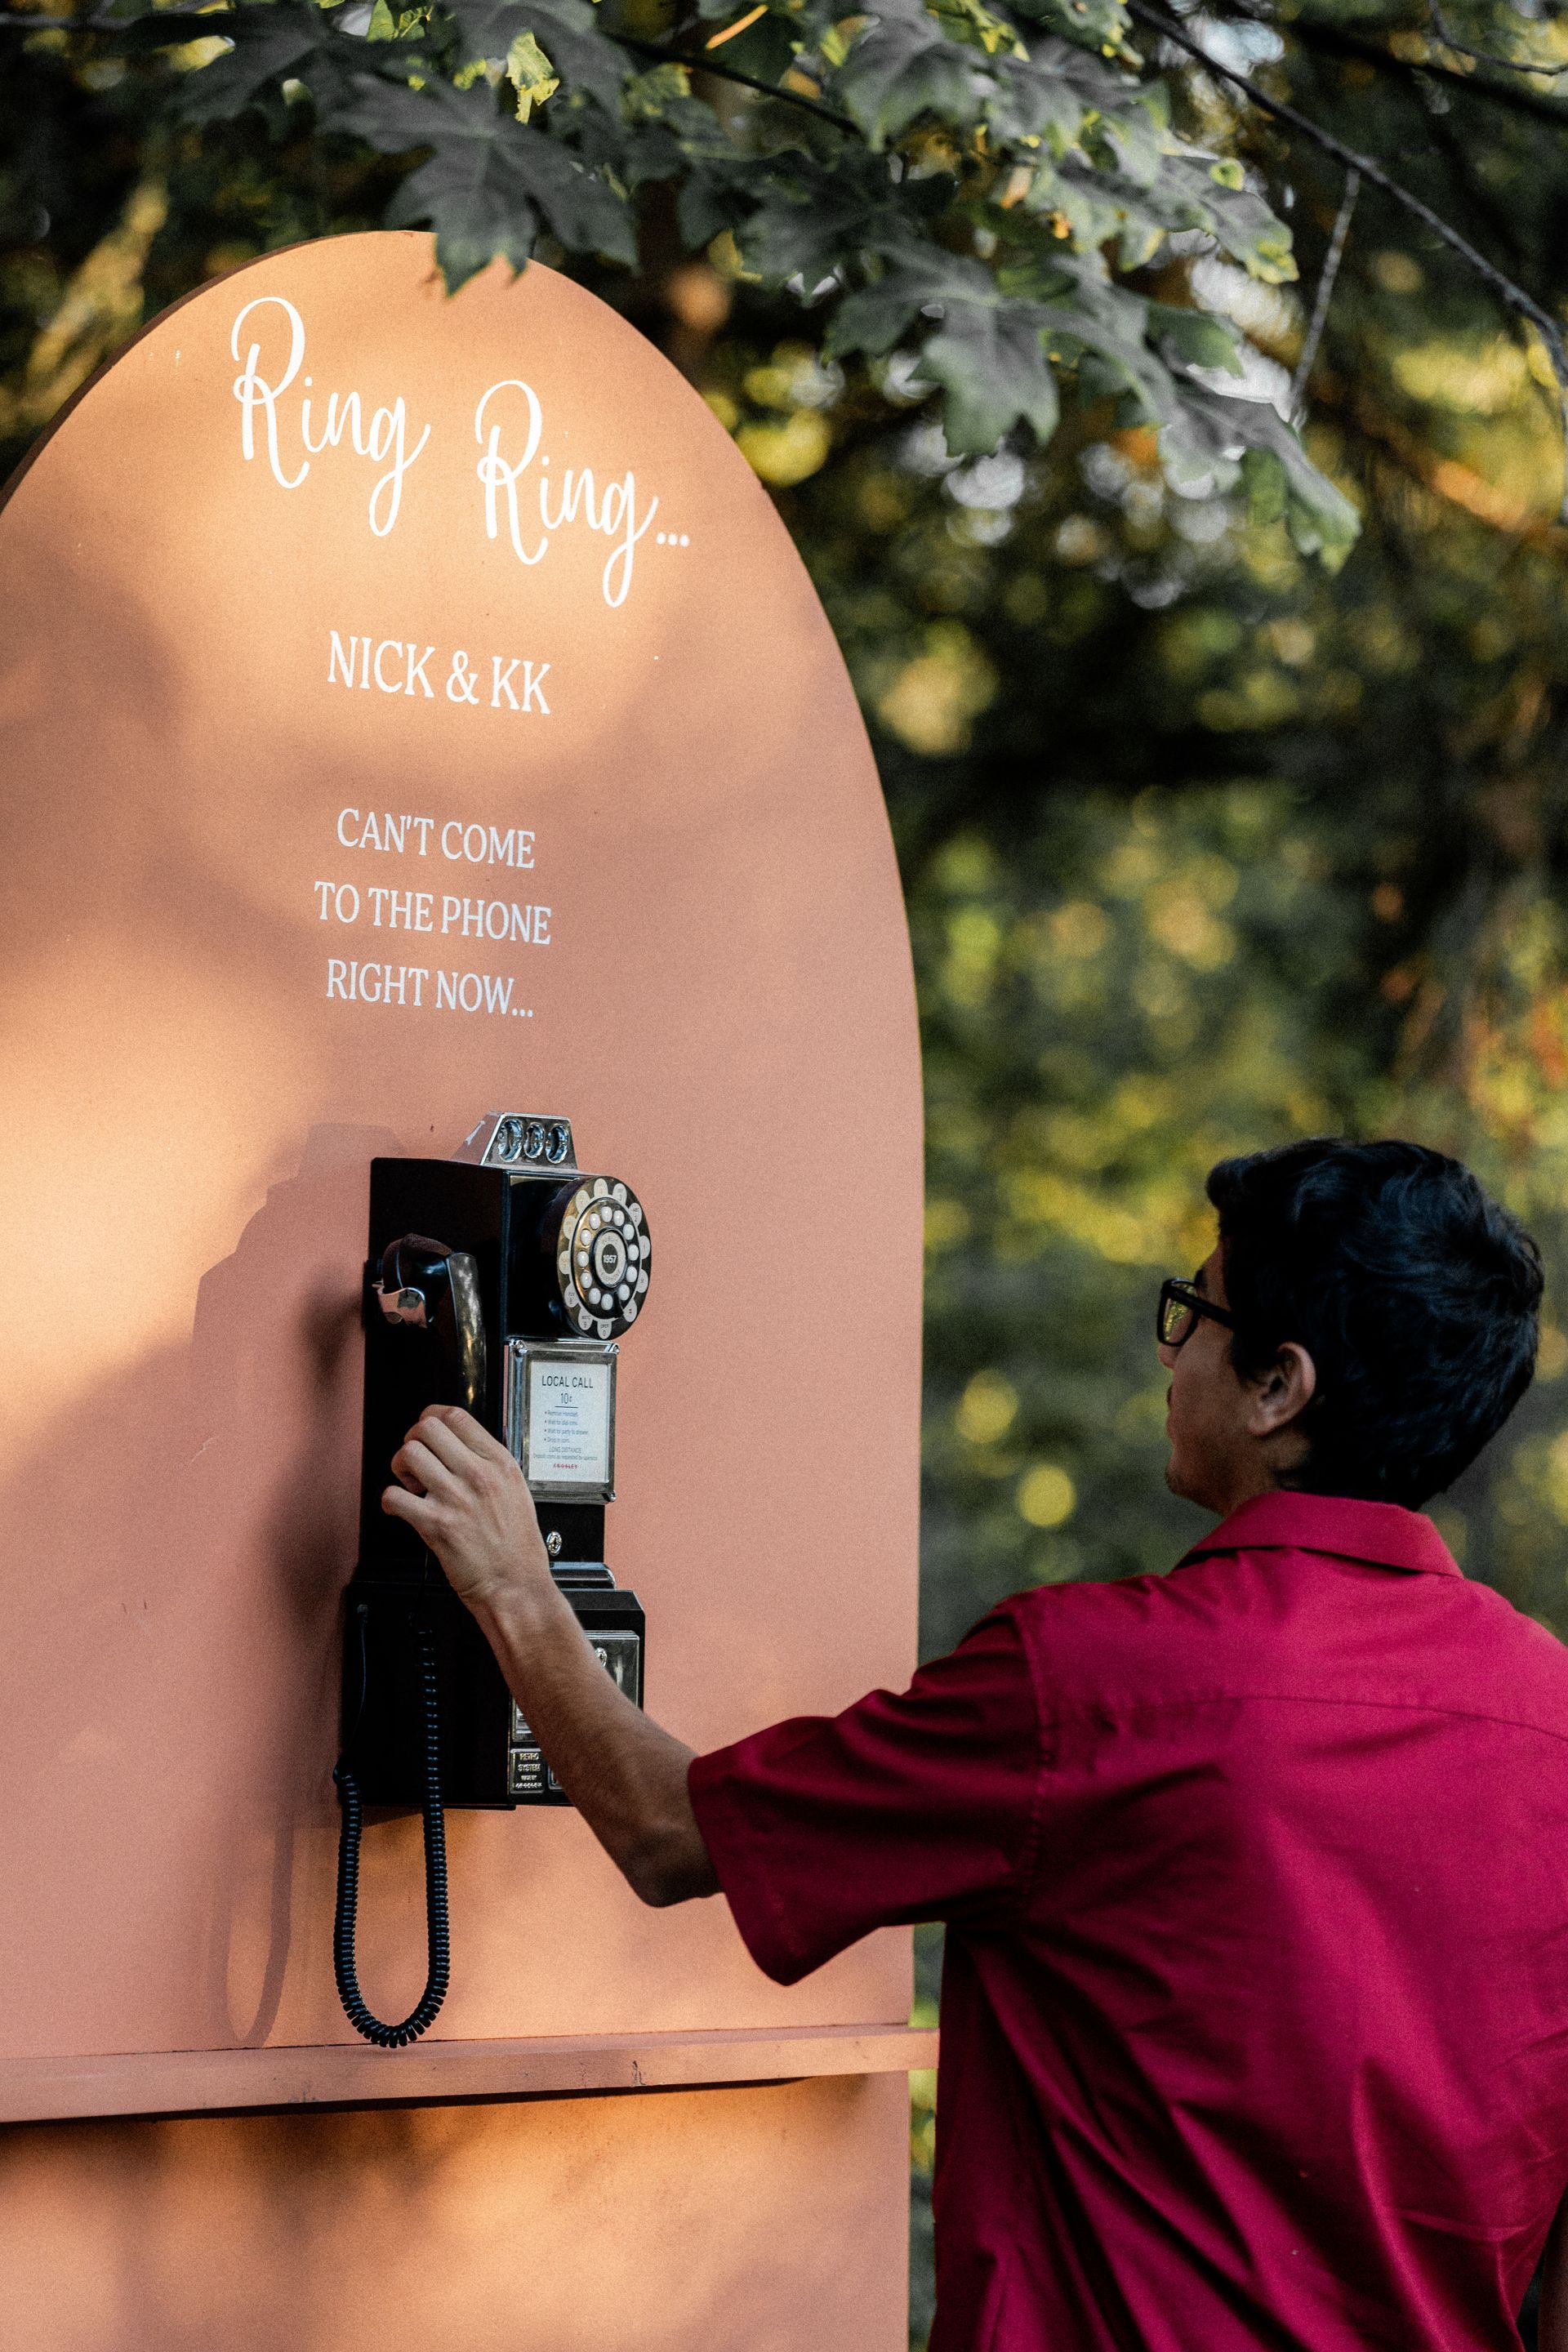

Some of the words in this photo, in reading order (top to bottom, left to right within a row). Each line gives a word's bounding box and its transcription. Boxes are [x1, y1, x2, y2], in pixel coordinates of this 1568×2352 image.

[230, 296, 431, 537] Ring
[474, 380, 689, 608] Ring...
[327, 630, 435, 698] NICK
[446, 650, 479, 705] &
[490, 656, 550, 715] KK
[336, 808, 434, 856] CAN'T
[441, 821, 536, 869] COME
[314, 880, 360, 924] TO
[368, 887, 434, 932] THE
[441, 895, 551, 945] PHONE
[326, 959, 430, 1007] RIGHT
[435, 970, 533, 1018] NOW...
[541, 1375, 570, 1388] LOCAL
[572, 1377, 594, 1388] CALL
